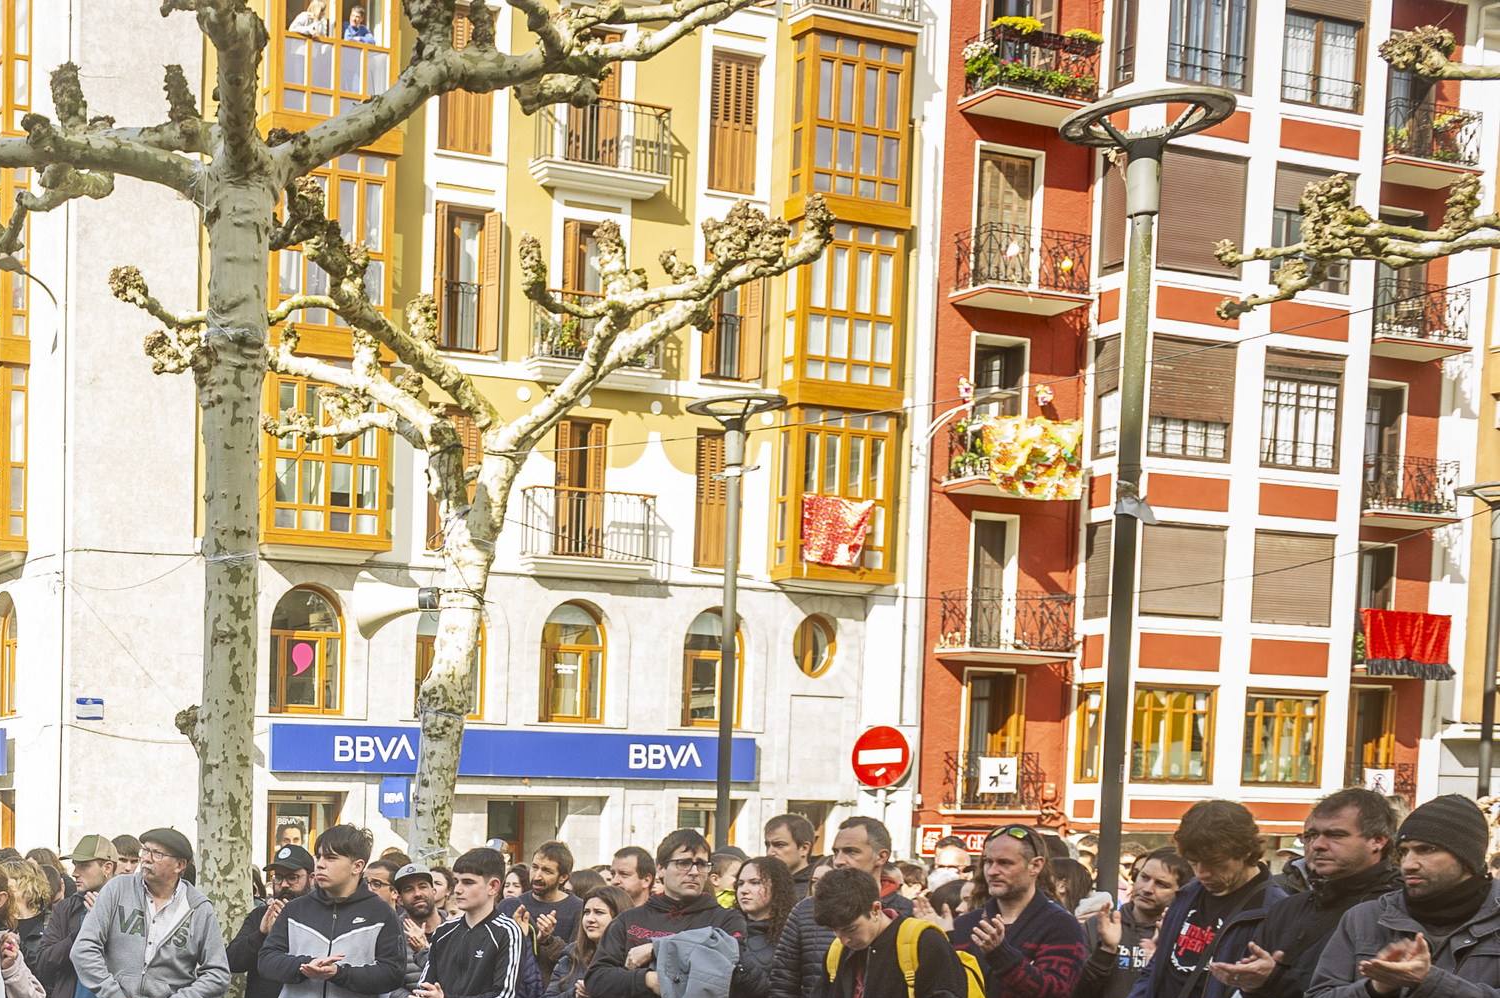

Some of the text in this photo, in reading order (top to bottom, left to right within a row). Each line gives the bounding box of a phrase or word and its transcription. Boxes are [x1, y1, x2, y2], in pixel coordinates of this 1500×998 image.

[334, 734, 416, 763] BBVA
[628, 742, 702, 770] BBVA
[384, 791, 404, 804] BBVA
[277, 817, 297, 826] BBVA
[118, 905, 190, 948] VAS
